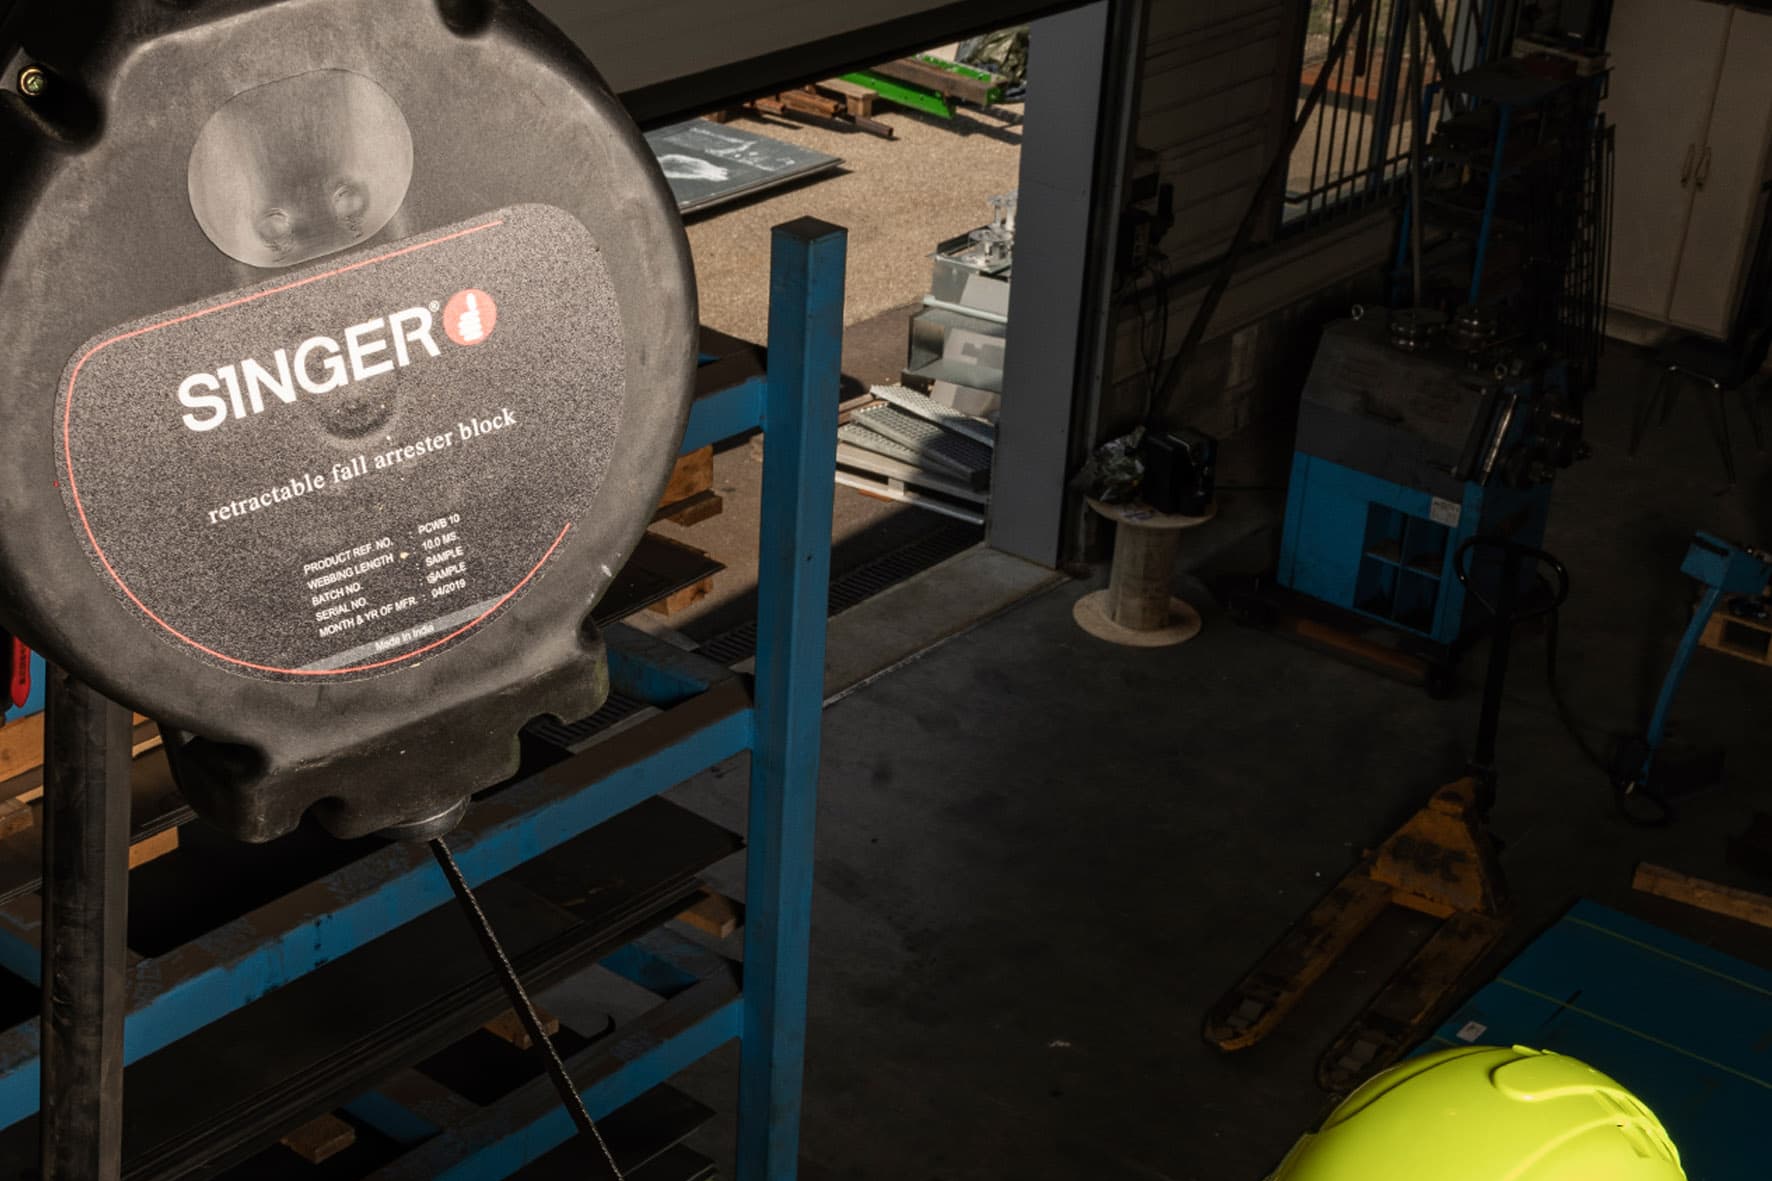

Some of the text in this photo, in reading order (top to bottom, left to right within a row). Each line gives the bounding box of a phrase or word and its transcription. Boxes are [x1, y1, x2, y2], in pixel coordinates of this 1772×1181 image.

[207, 408, 517, 524] retractable fall arrester block
[303, 550, 352, 575] PRODUCT
[376, 537, 394, 550] NO.
[418, 518, 448, 535] PCWB
[449, 513, 460, 525] 10
[307, 567, 354, 590] WEBBING
[355, 553, 394, 575] LENGTH
[422, 536, 441, 551] 10.0
[312, 546, 465, 606] BATCH NO. SAMPLE
[316, 603, 351, 622] SERIAL
[319, 618, 355, 638] MONTH
[356, 615, 364, 625] &
[364, 609, 379, 621] YR
[380, 603, 393, 616] OF
[431, 578, 467, 599] 04/2019
[375, 636, 400, 652] Made
[412, 624, 435, 637] India
